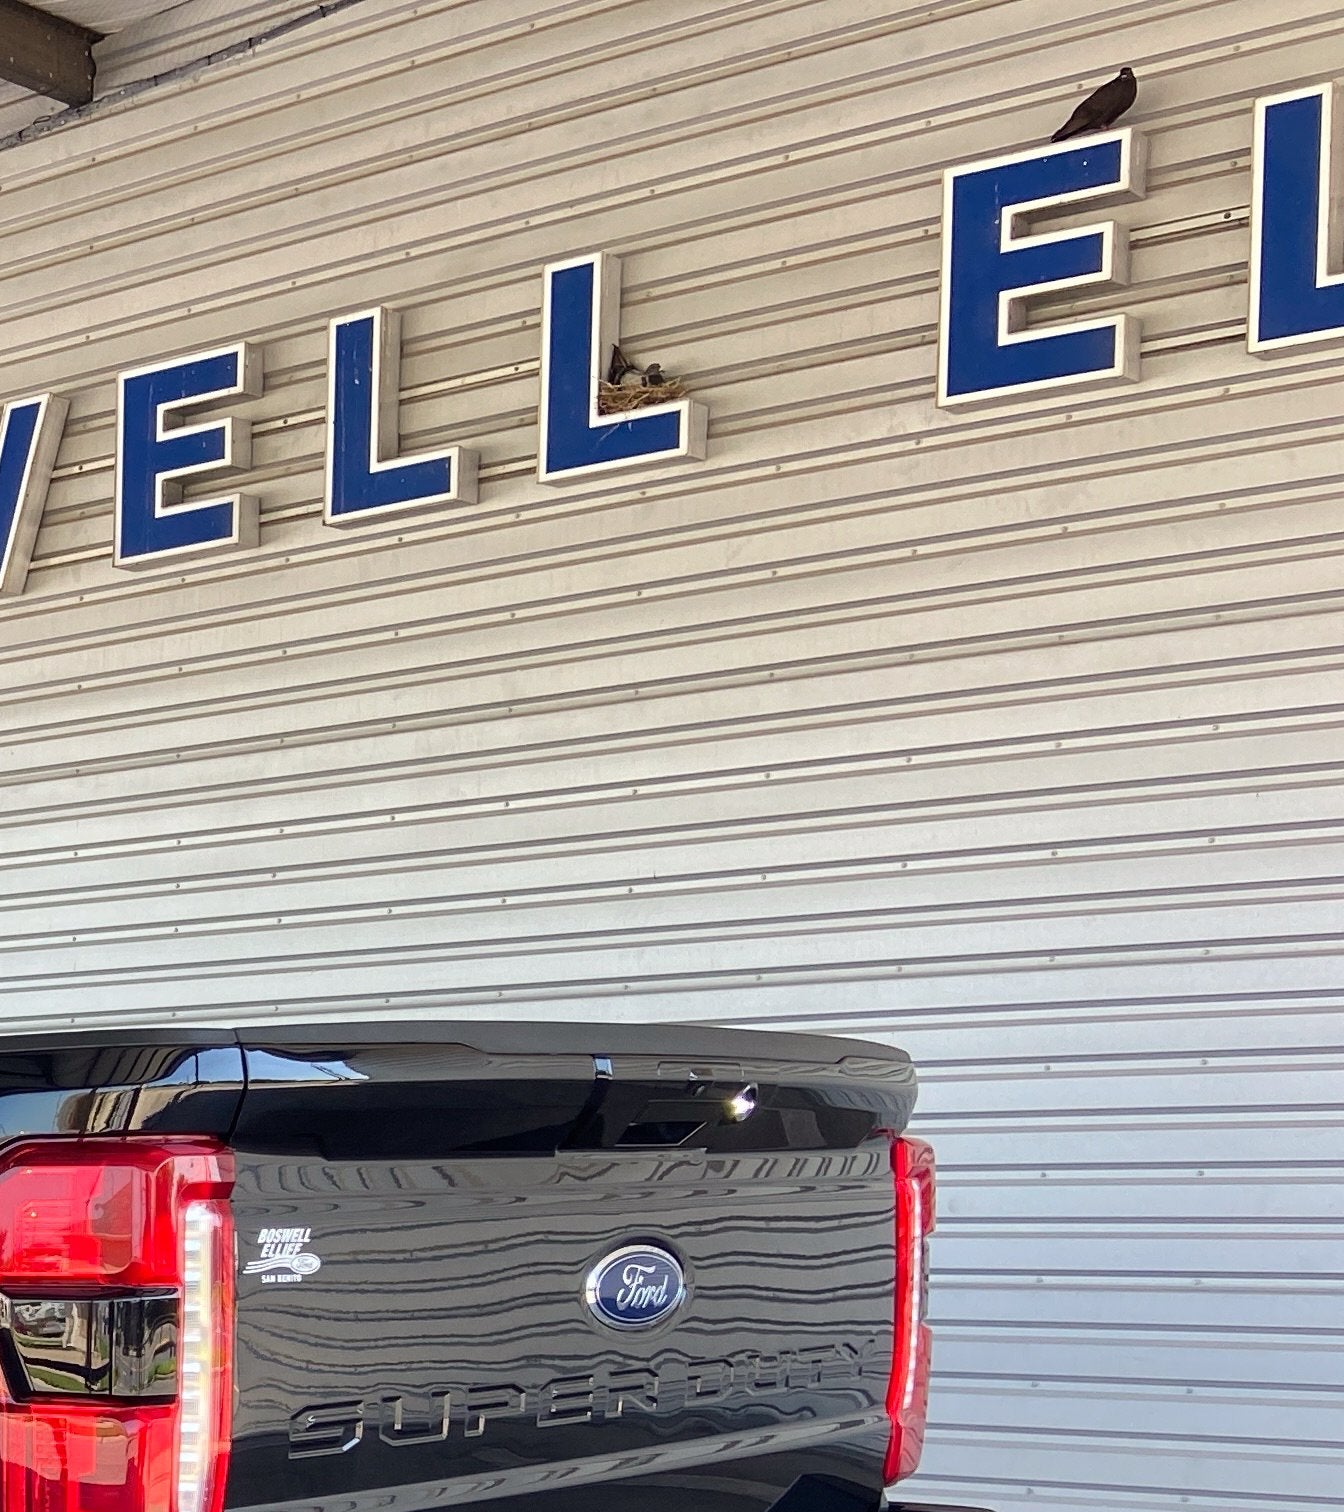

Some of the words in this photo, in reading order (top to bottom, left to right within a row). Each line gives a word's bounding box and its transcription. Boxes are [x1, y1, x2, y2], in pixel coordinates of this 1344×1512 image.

[257, 1228, 312, 1244] BOSWELL
[261, 1274, 276, 1283] SAN
[616, 1264, 669, 1311] Ford
[288, 1366, 660, 1460] SUPER
[685, 1338, 875, 1408] DUTY
